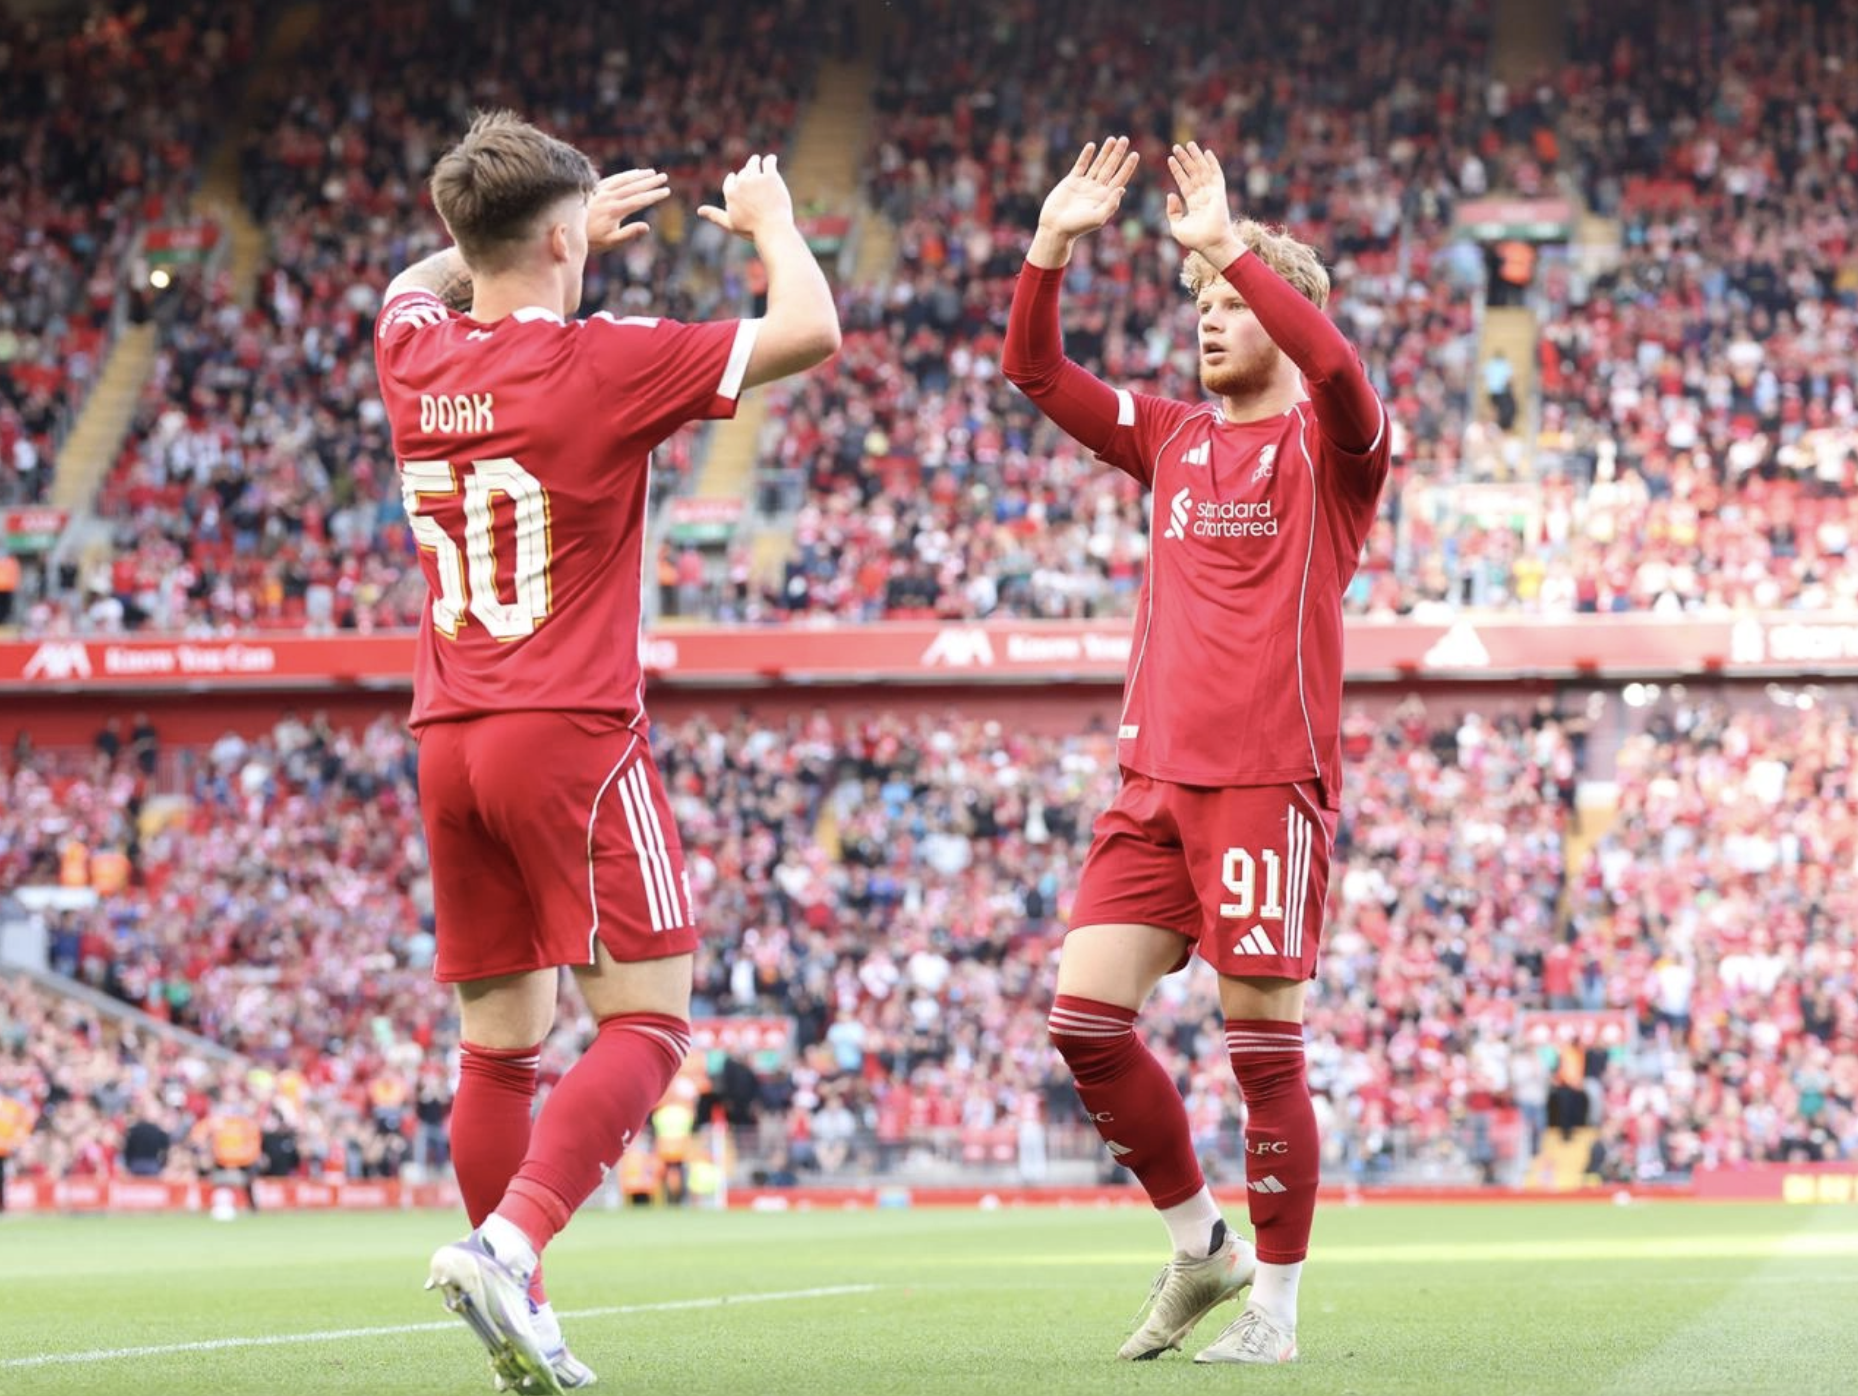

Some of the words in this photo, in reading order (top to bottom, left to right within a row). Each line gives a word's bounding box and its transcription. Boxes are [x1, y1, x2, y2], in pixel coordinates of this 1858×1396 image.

[420, 392, 494, 434] DOAK
[401, 457, 553, 643] 50
[1219, 846, 1283, 920] 91
